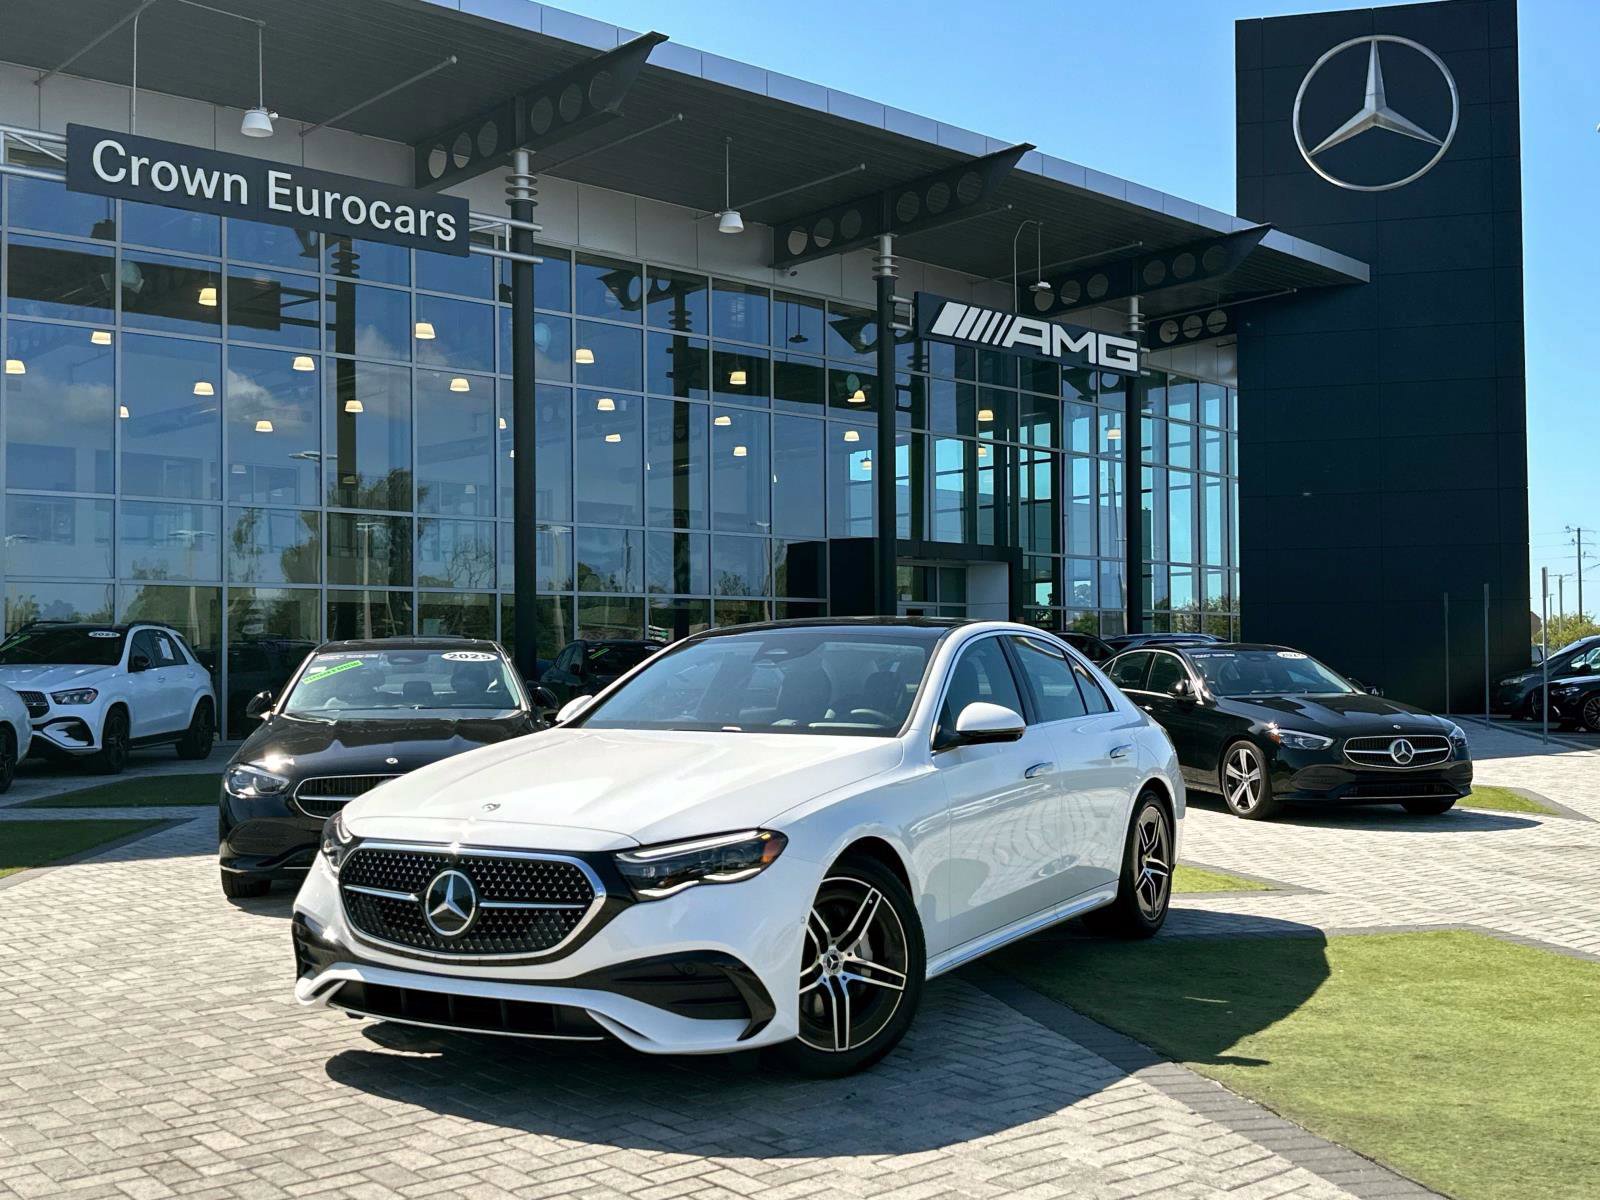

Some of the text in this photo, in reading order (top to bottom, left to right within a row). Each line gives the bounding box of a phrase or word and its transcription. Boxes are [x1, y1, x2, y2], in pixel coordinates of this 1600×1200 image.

[92, 139, 457, 243] Crown Eurocars
[1002, 315, 1138, 372] AMG
[448, 652, 491, 660] 2025
